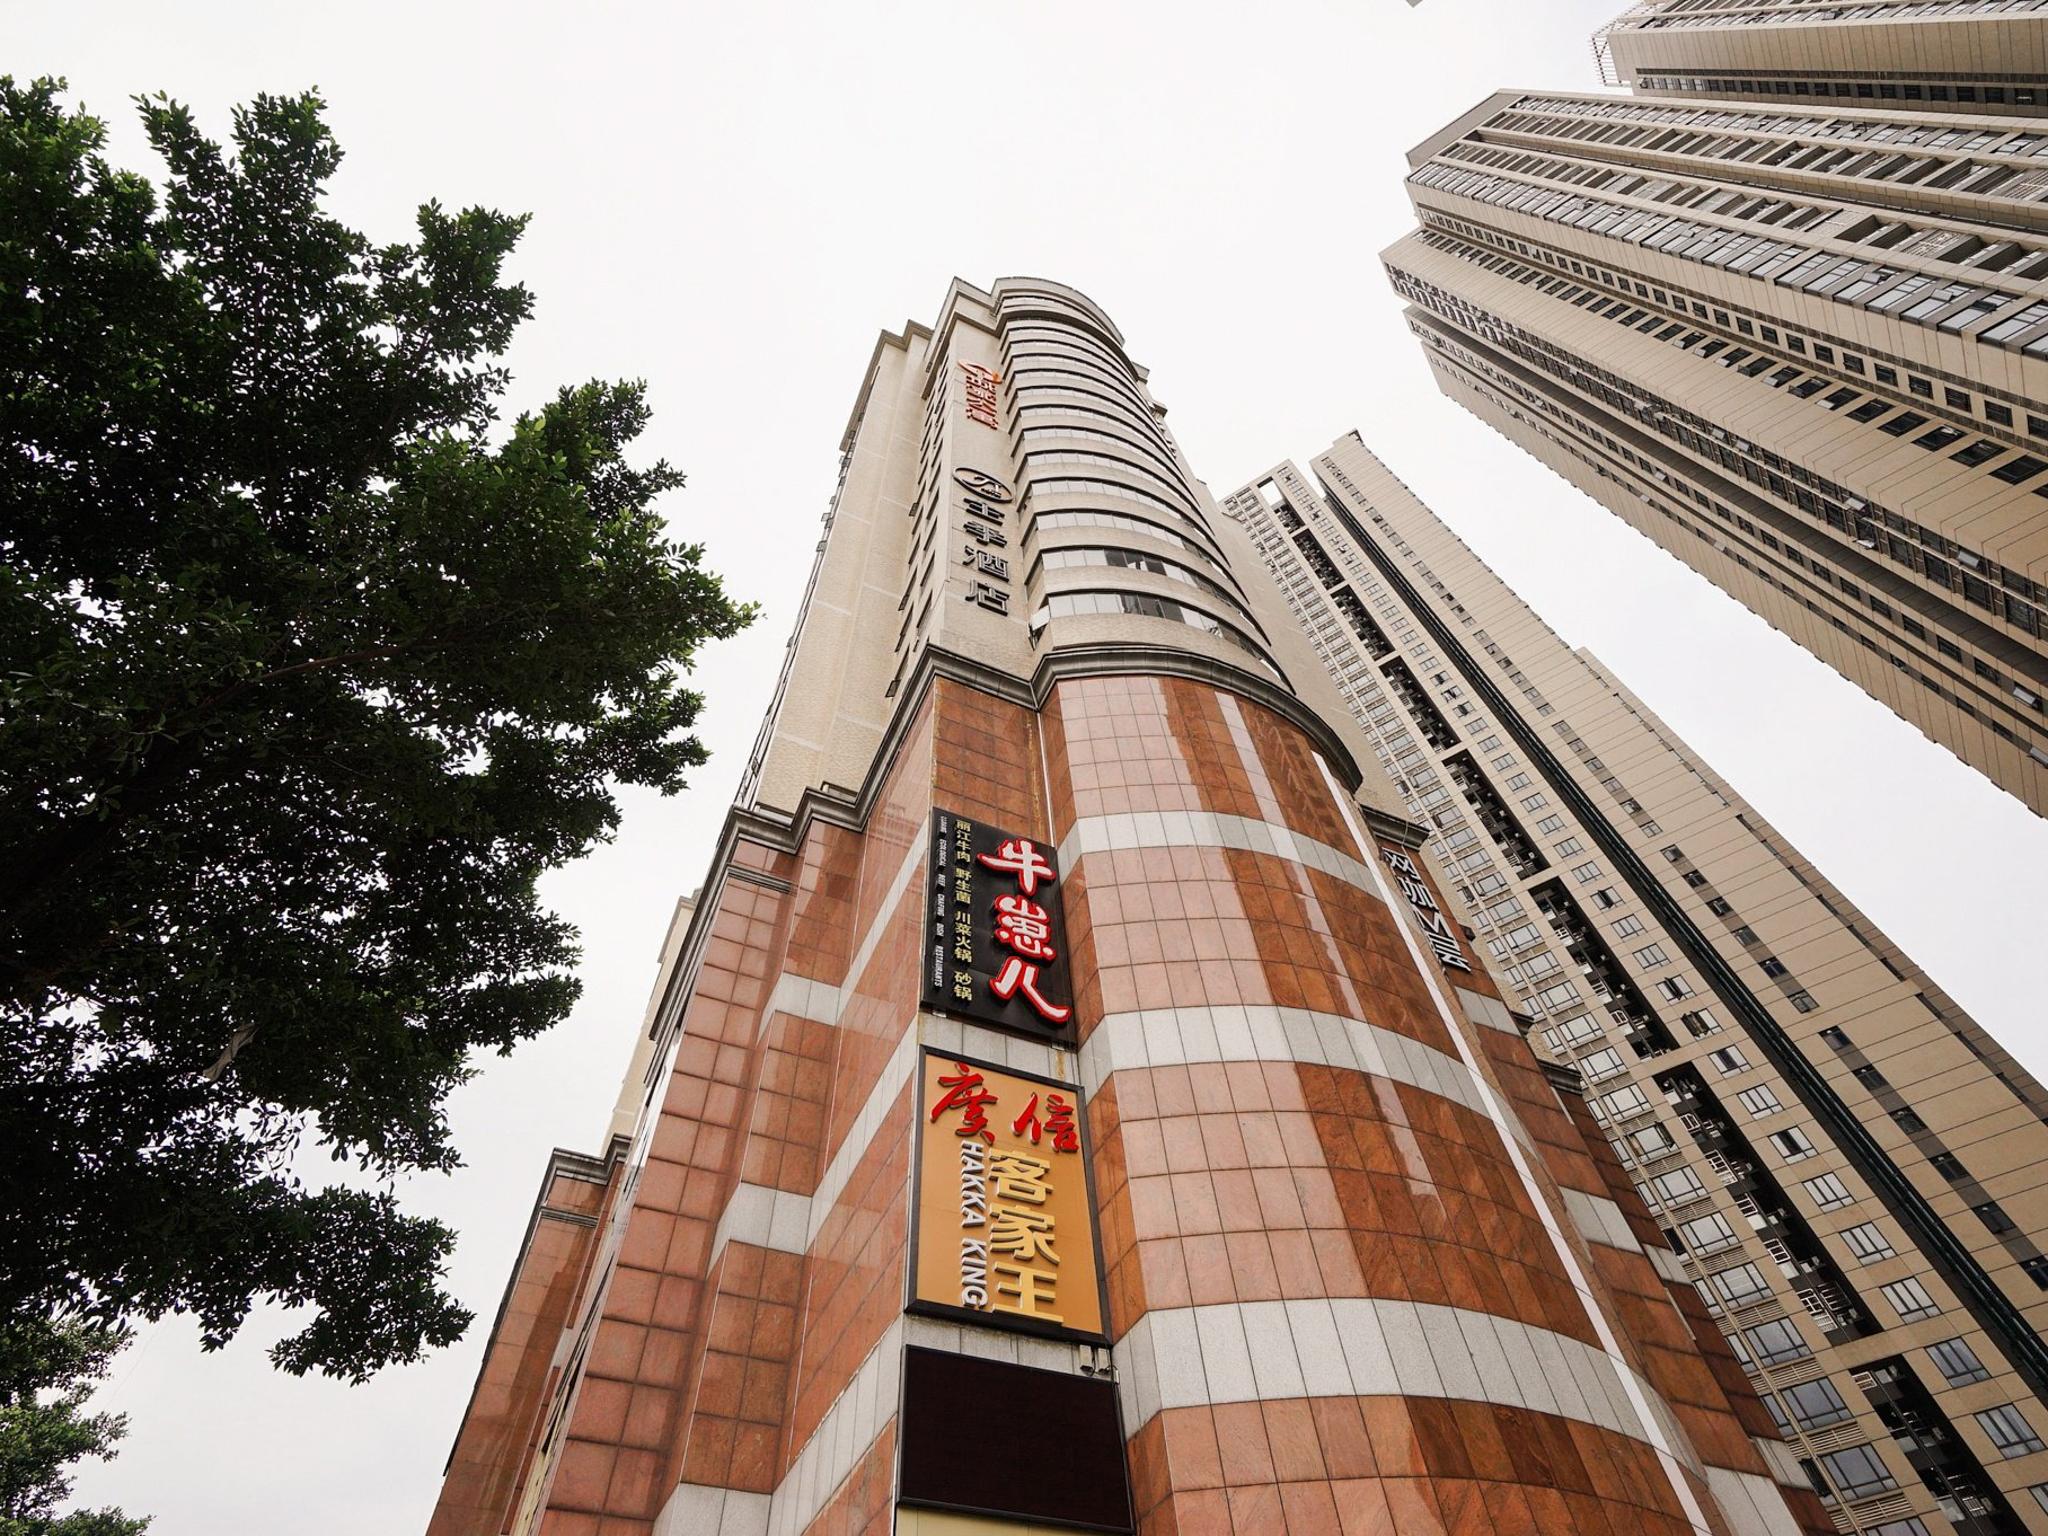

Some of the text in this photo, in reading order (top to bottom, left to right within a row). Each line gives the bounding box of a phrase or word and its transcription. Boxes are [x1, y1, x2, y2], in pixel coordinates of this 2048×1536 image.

[954, 819, 973, 1001] 丽江牛肉 野生菌 川菜火锅 砂锅
[960, 1139, 989, 1312] HAKKA KING
[988, 1147, 1064, 1327] 客家王
